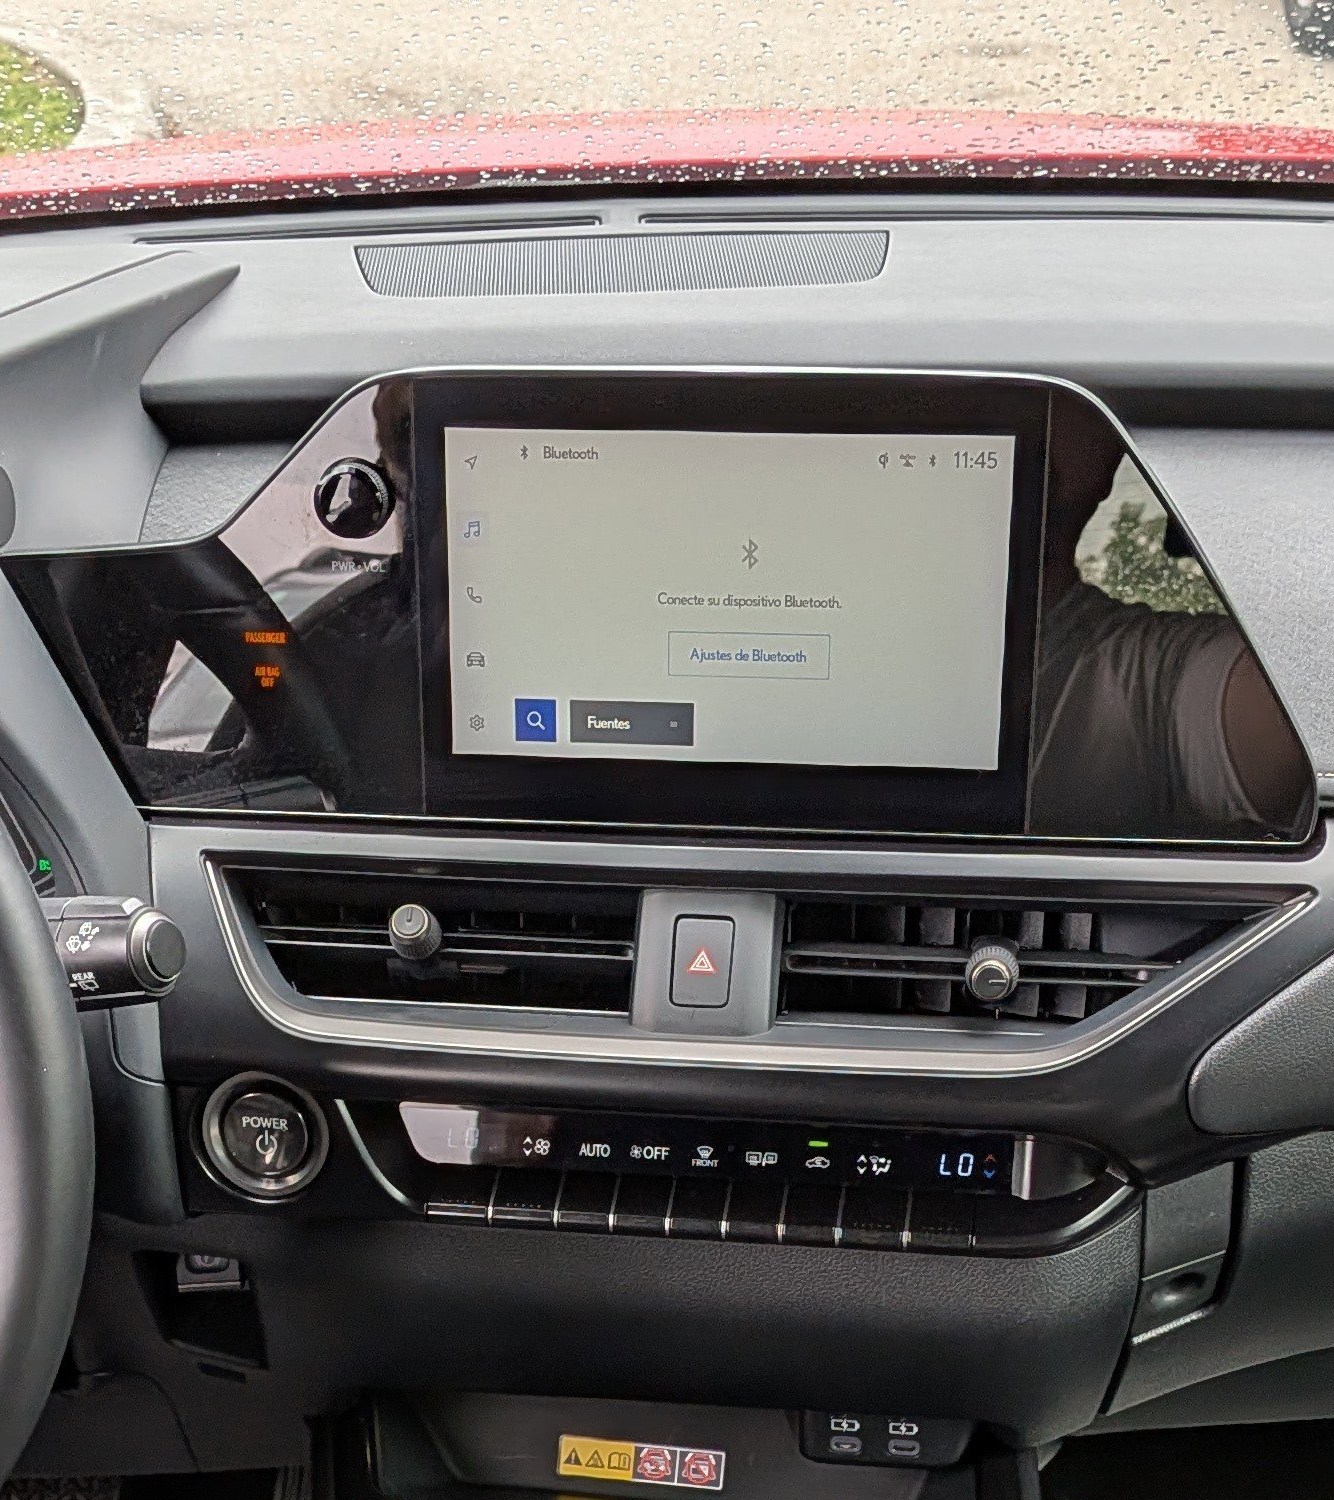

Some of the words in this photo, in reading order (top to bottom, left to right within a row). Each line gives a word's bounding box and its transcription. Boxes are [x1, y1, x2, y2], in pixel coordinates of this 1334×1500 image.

[542, 445, 599, 462] Bluetooth
[952, 450, 999, 471] 11:45
[658, 592, 704, 608] Conecte
[707, 596, 722, 609] su
[723, 593, 782, 611] dispositivo
[245, 631, 286, 644] PASSENGER
[689, 647, 732, 665] Ajustes
[734, 648, 750, 663] de
[751, 648, 808, 664] Bluetooth
[587, 715, 631, 731] Fuentes
[72, 971, 96, 981] REAR
[241, 1115, 288, 1131] POWER
[578, 1143, 611, 1158] AUTO
[643, 1146, 670, 1161] OFF
[691, 1159, 719, 1168] FRONT
